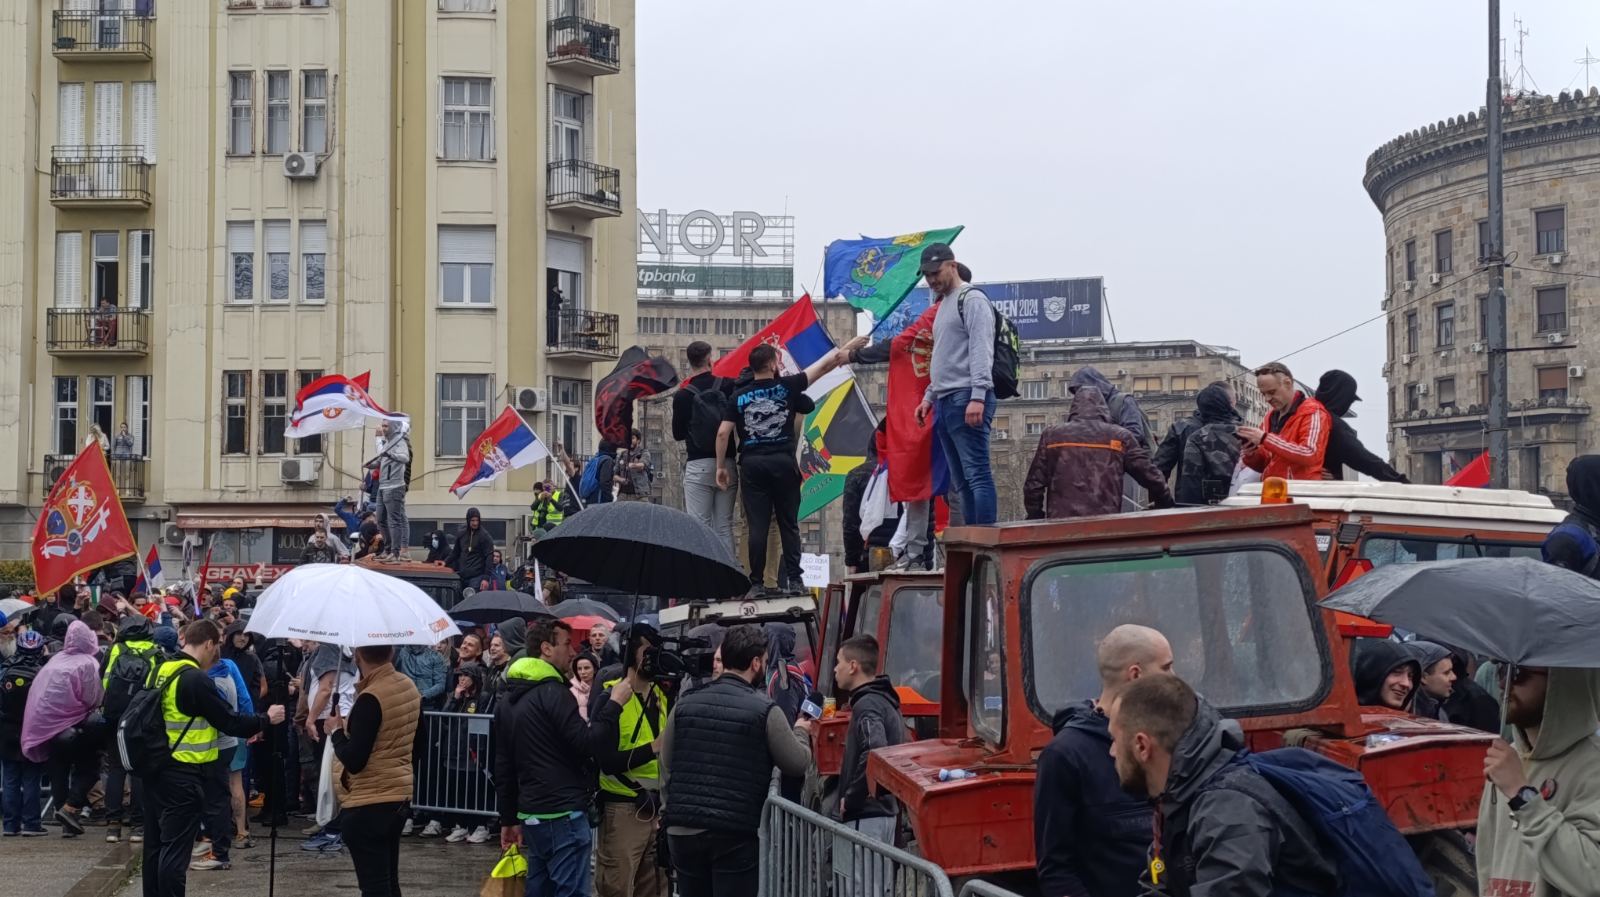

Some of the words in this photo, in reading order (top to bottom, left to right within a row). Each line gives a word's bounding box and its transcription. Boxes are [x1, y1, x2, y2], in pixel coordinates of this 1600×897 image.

[637, 268, 696, 285] tpbanka
[990, 299, 1018, 317] PEN
[1019, 299, 1039, 316] 2024
[743, 606, 755, 616] 30
